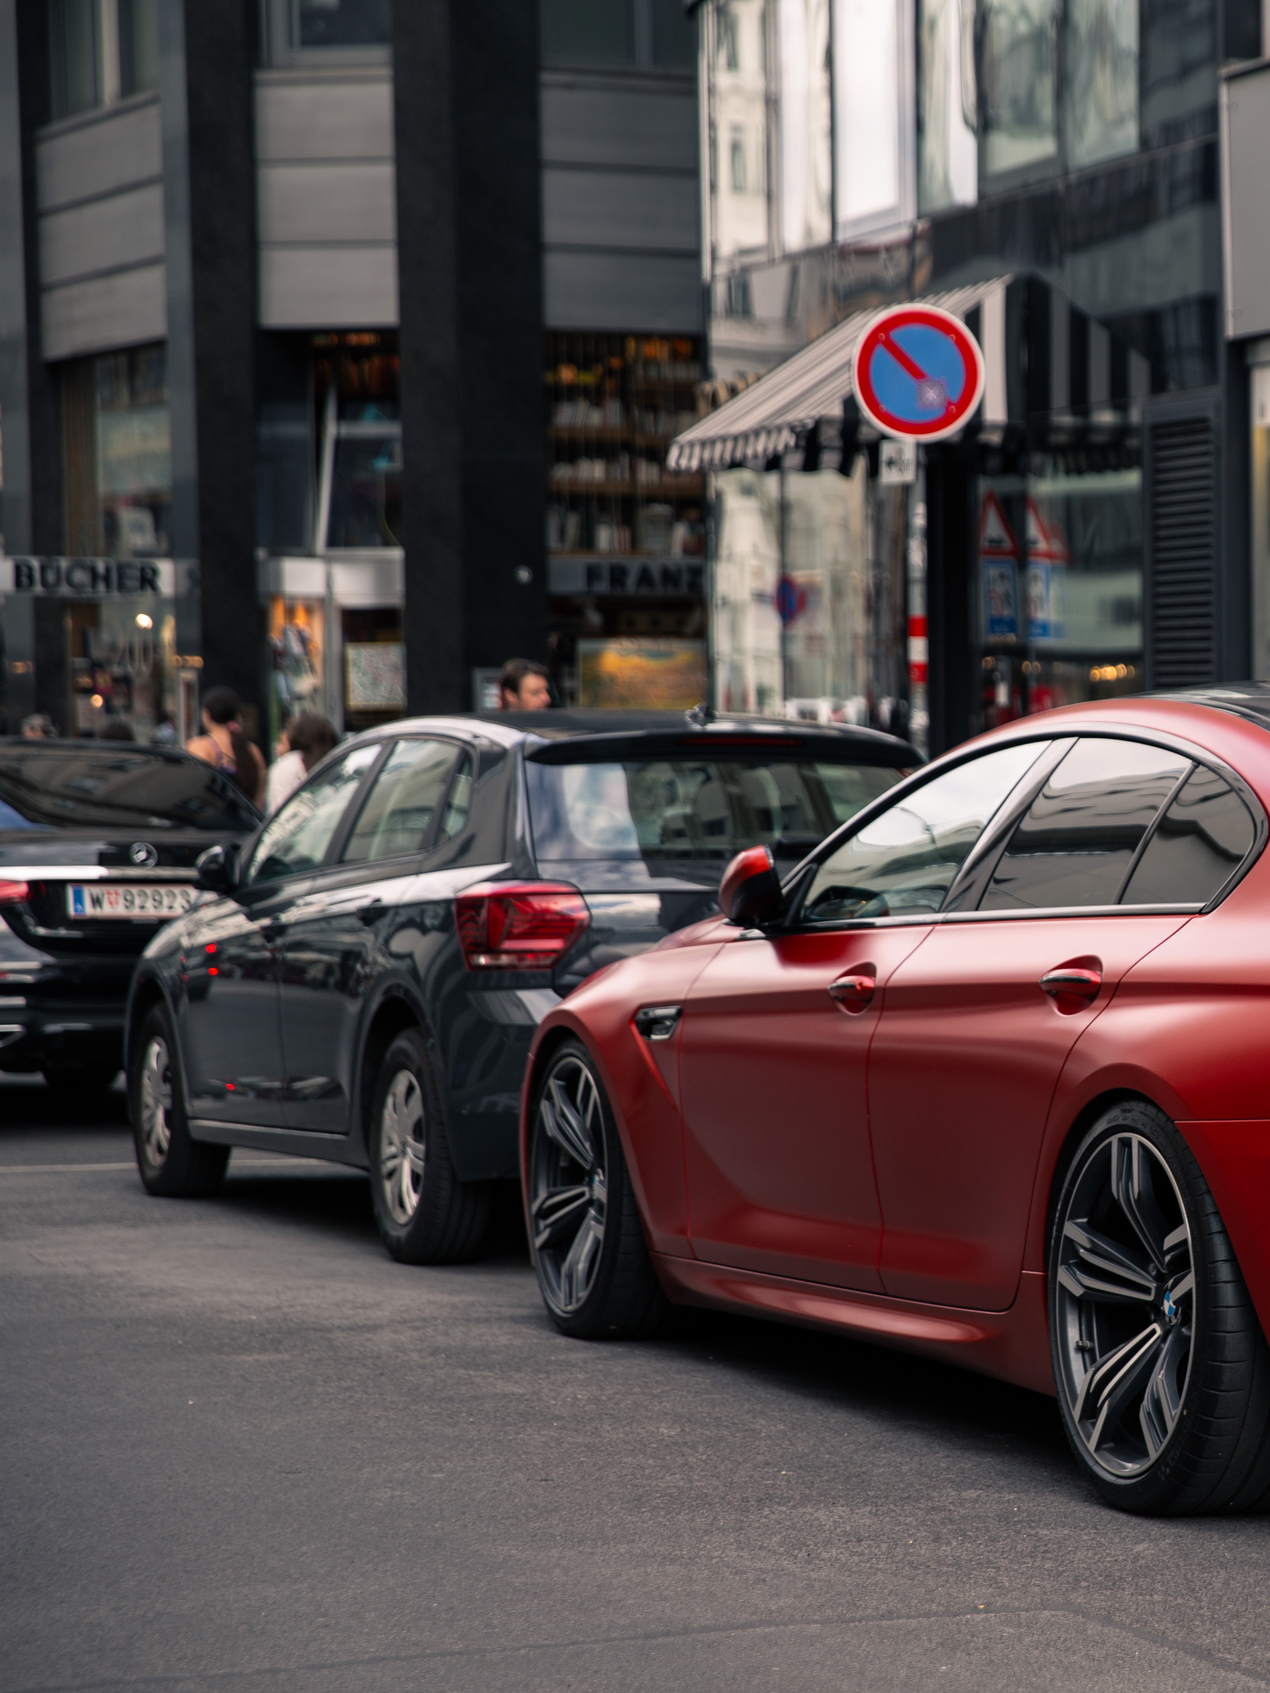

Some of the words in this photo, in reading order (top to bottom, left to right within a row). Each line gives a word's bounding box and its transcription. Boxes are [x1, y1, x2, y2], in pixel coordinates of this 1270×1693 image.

[14, 556, 162, 593] BÜCHER
[586, 562, 707, 592] FRANZ
[89, 888, 105, 911] W
